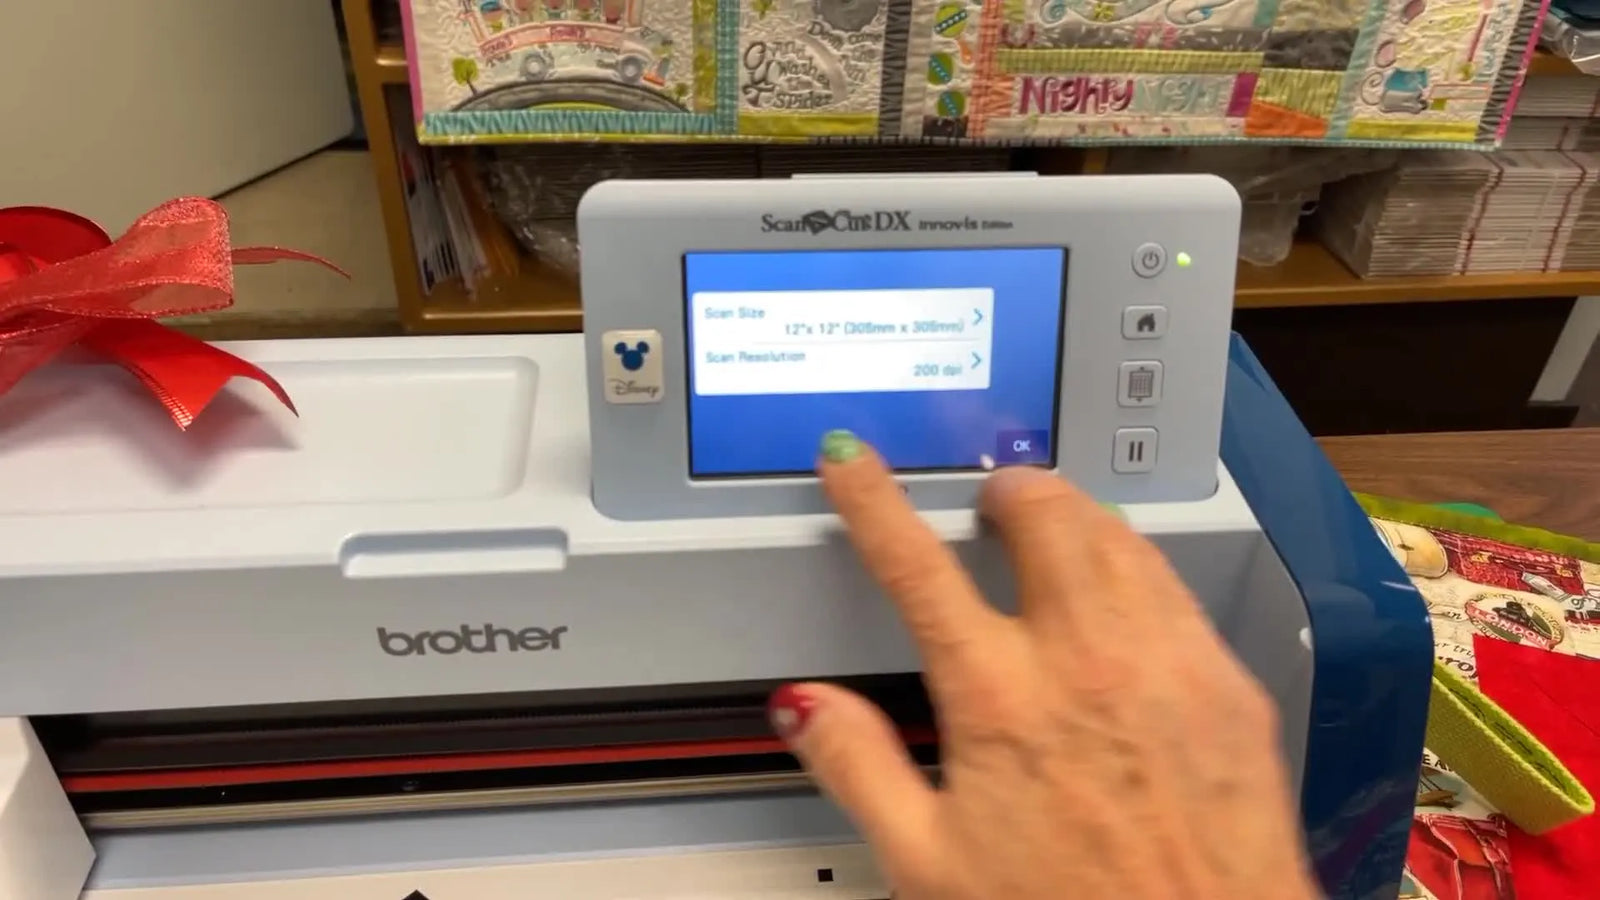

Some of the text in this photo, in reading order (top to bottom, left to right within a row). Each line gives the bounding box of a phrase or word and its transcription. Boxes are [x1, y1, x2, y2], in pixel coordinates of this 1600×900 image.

[1018, 76, 1134, 115] Nighty
[874, 210, 911, 232] DX
[705, 306, 765, 319] Scan Size
[706, 350, 806, 363] Scan Resolution
[913, 364, 939, 376] 200
[1013, 439, 1031, 452] OK
[1475, 608, 1549, 647] LONDON
[376, 623, 568, 656] brother
